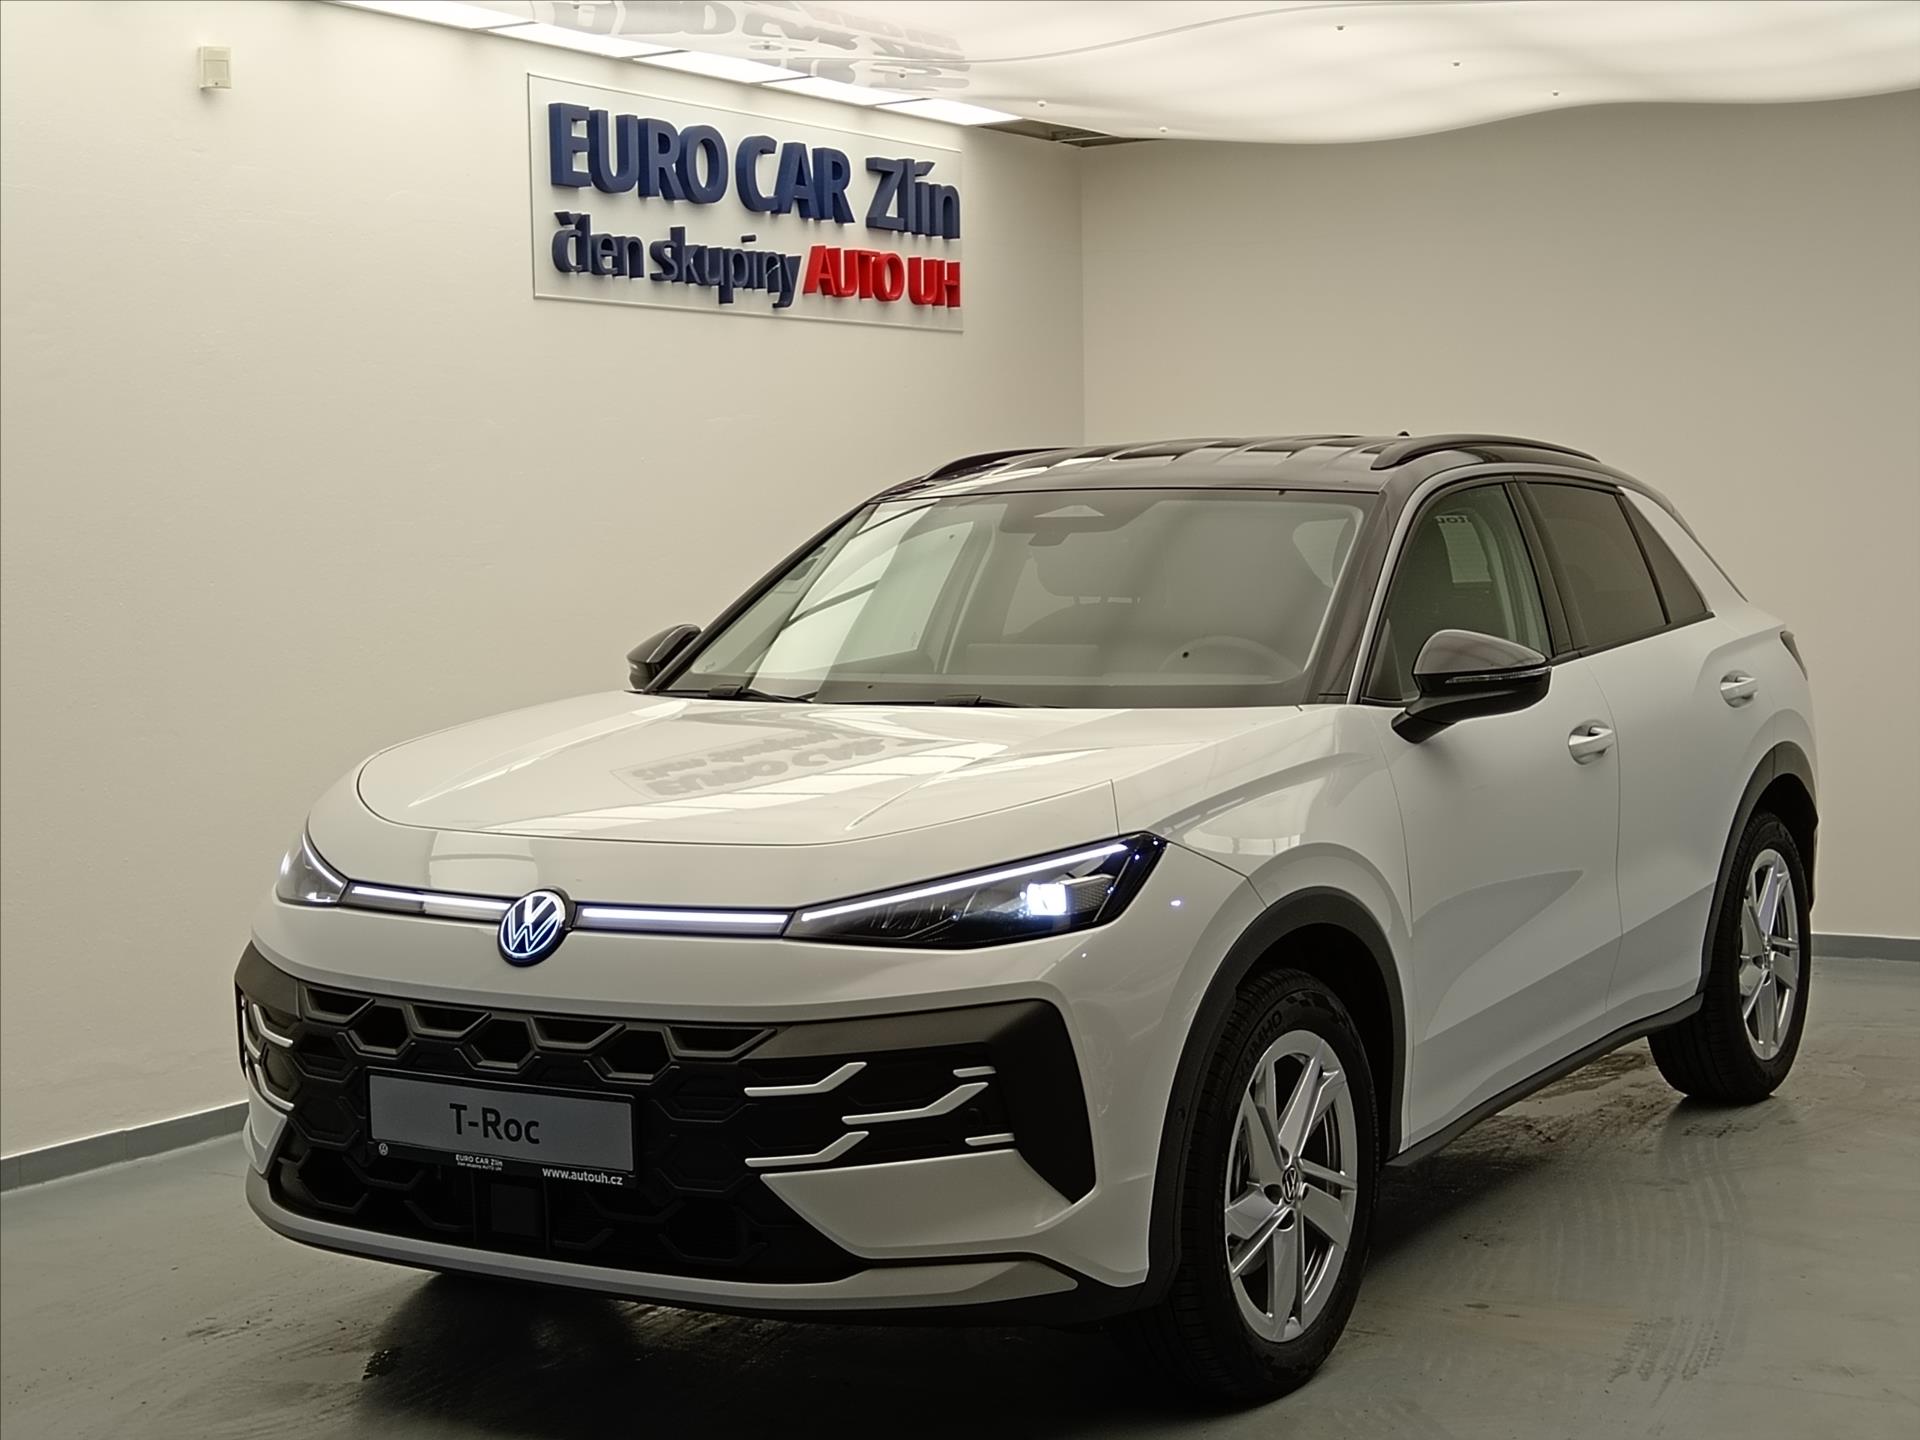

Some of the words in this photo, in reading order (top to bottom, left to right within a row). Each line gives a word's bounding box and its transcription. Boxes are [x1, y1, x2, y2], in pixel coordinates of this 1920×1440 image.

[548, 103, 728, 204] EURO
[735, 135, 855, 224] CAR
[866, 157, 960, 239] Zlín
[552, 211, 644, 278] člen
[650, 226, 802, 308] skupiny
[803, 245, 905, 302] AUTO
[908, 257, 960, 307] UH
[500, 890, 567, 957] VW
[449, 1103, 540, 1144] T-Roc
[542, 1167, 624, 1186] www.autouh.cz
